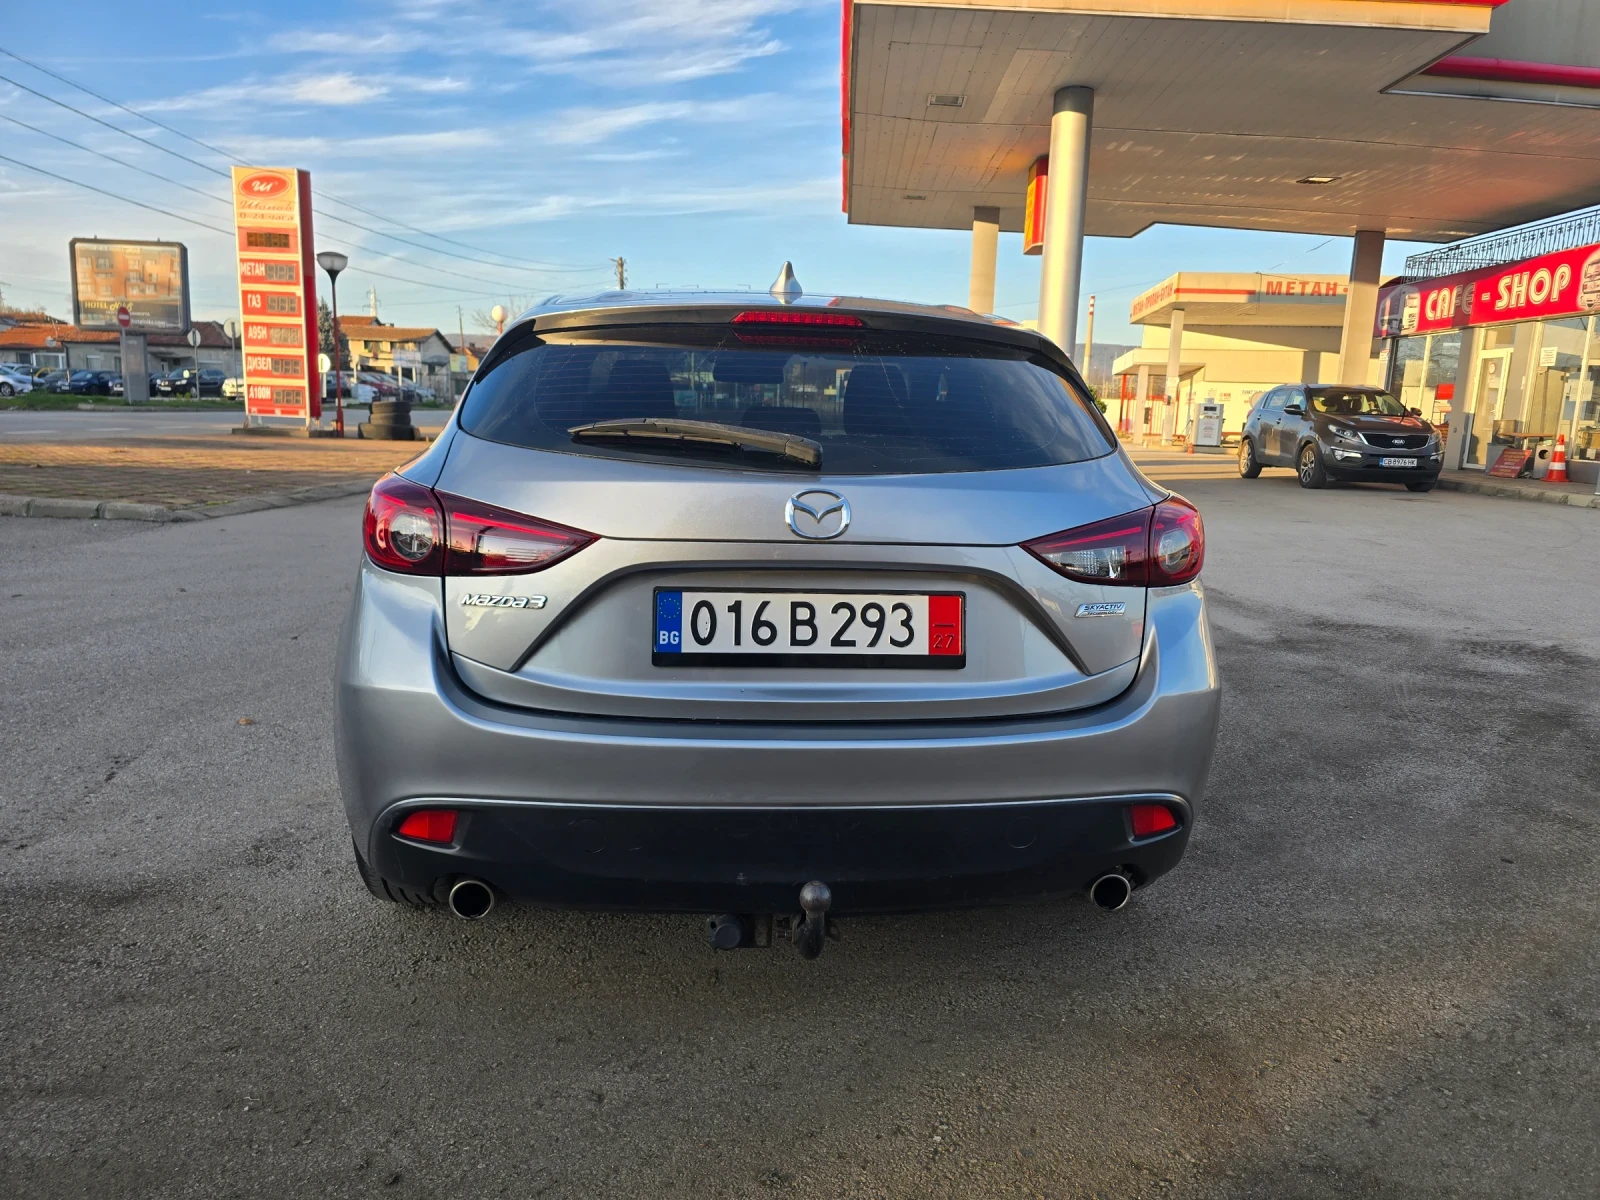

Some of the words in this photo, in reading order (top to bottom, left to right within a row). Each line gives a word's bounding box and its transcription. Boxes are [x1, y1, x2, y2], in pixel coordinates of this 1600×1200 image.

[240, 261, 265, 276] МЕТАН
[1265, 281, 1338, 296] МЕТАН
[1425, 282, 1476, 321] CAFE
[1494, 264, 1572, 311] SHOP
[247, 293, 262, 308] ГАЗ
[247, 356, 272, 372] ДИЗЕЛ
[690, 599, 778, 646] 016
[789, 601, 818, 647] B
[830, 602, 915, 648] 293
[659, 630, 679, 645] BG
[933, 634, 954, 648] 27
